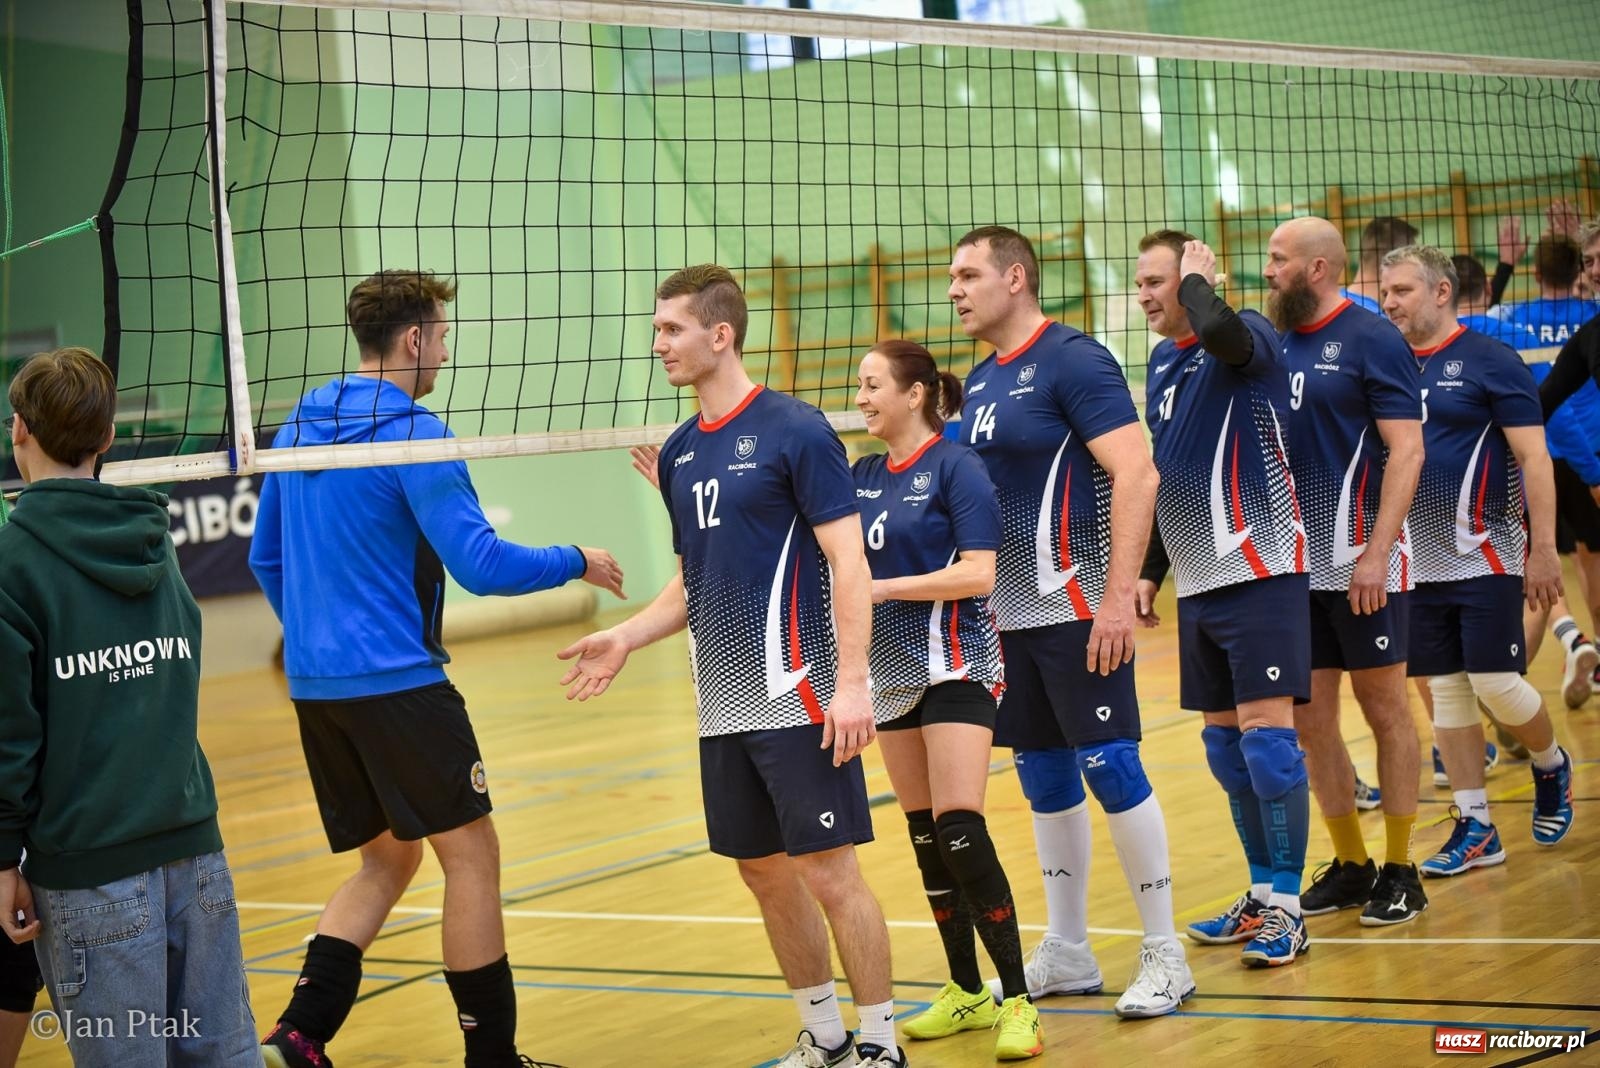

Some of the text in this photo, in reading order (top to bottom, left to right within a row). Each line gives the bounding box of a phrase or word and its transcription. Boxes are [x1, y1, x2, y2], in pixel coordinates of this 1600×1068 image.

[1289, 371, 1305, 411] 9
[970, 402, 997, 444] 14
[727, 461, 758, 471] RACIBÓRZ
[692, 478, 721, 530] 12
[867, 510, 888, 551] 6
[54, 636, 193, 681] UNKNOWN
[108, 663, 155, 684] IS FINE
